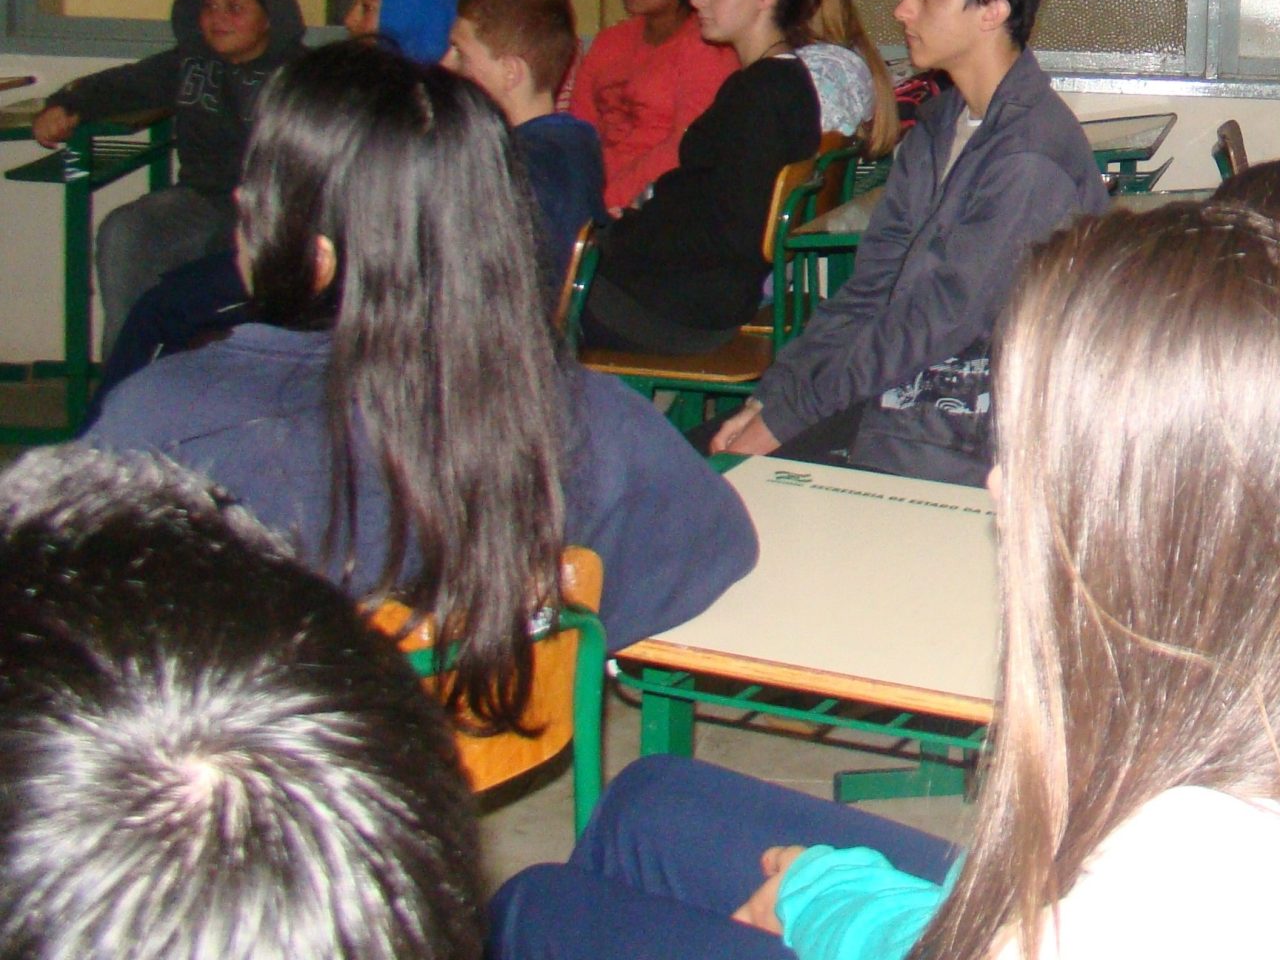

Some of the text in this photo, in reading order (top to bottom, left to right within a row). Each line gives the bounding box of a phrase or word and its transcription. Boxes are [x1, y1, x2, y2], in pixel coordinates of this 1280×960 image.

[809, 483, 884, 500] SECRETARIA
[889, 495, 906, 503] DE
[909, 498, 959, 511] ESTADO
